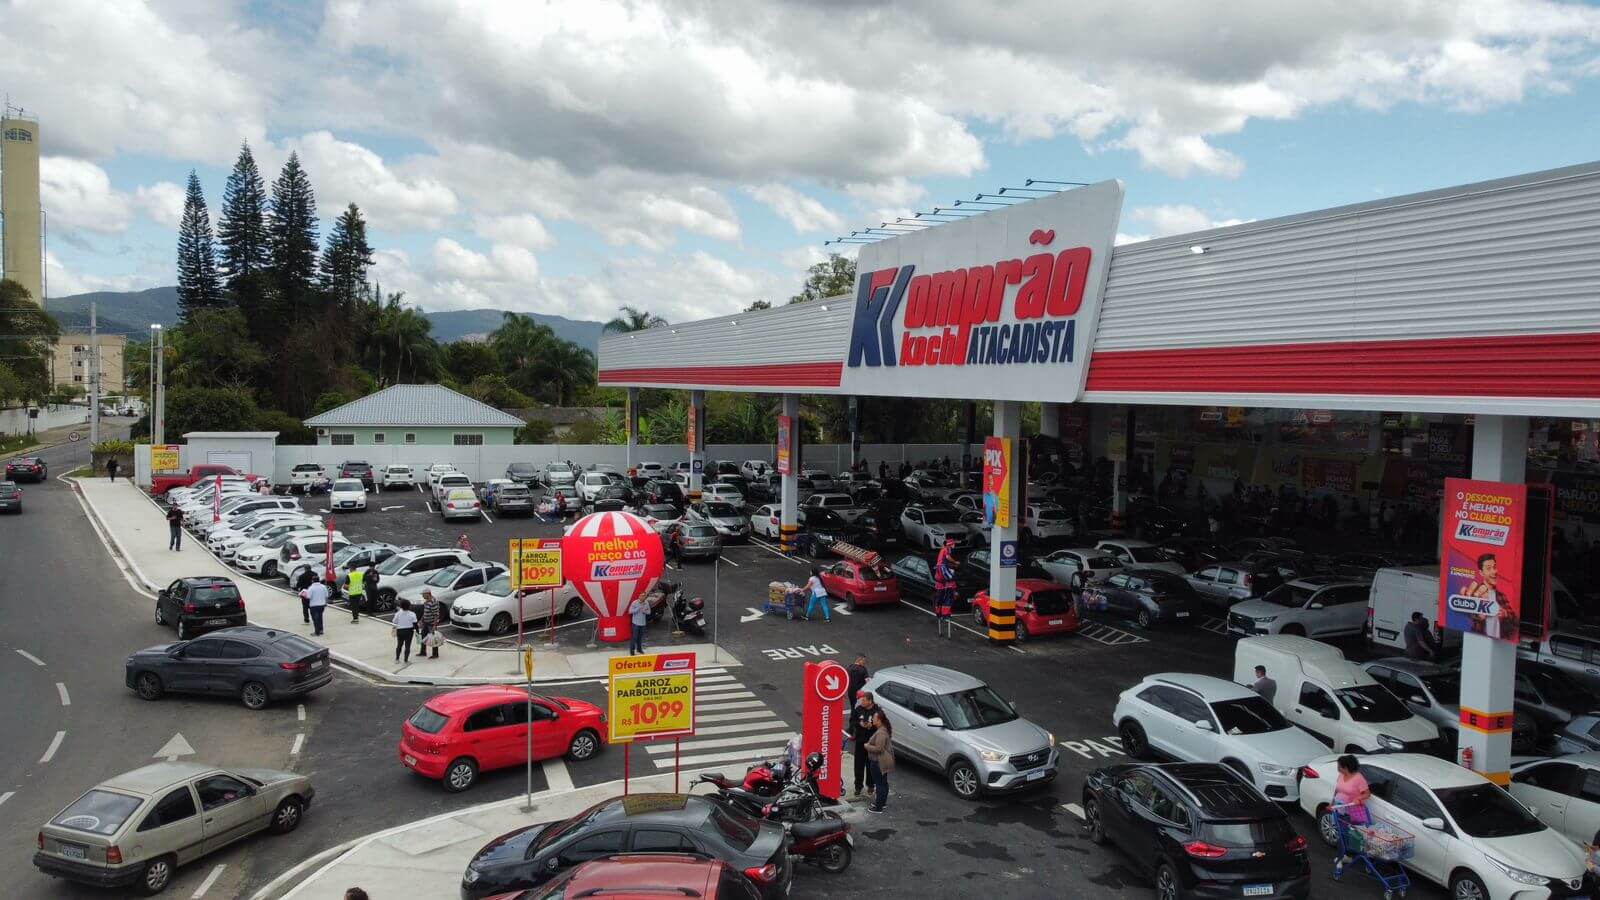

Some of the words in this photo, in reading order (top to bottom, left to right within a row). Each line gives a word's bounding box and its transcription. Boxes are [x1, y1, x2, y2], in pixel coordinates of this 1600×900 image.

[967, 319, 1076, 365] ATACADISTA
[985, 449, 1002, 468] PIX
[1466, 493, 1512, 505] DESCONTO
[1463, 501, 1469, 510] É
[1470, 503, 1504, 514] MELHOR
[1455, 510, 1468, 519] NO
[1470, 512, 1497, 523] CLUBE
[1498, 515, 1512, 525] DO
[593, 538, 639, 551] melhor
[588, 551, 622, 564] preço
[624, 547, 631, 558] é
[633, 549, 645, 558] no
[1453, 599, 1475, 609] clube
[761, 644, 840, 660] PARE
[616, 661, 652, 670] Ofertas
[635, 678, 671, 688] ARROZ
[617, 686, 688, 698] PARBOILIZADO
[1470, 713, 1477, 726] E
[1497, 716, 1504, 728] E
